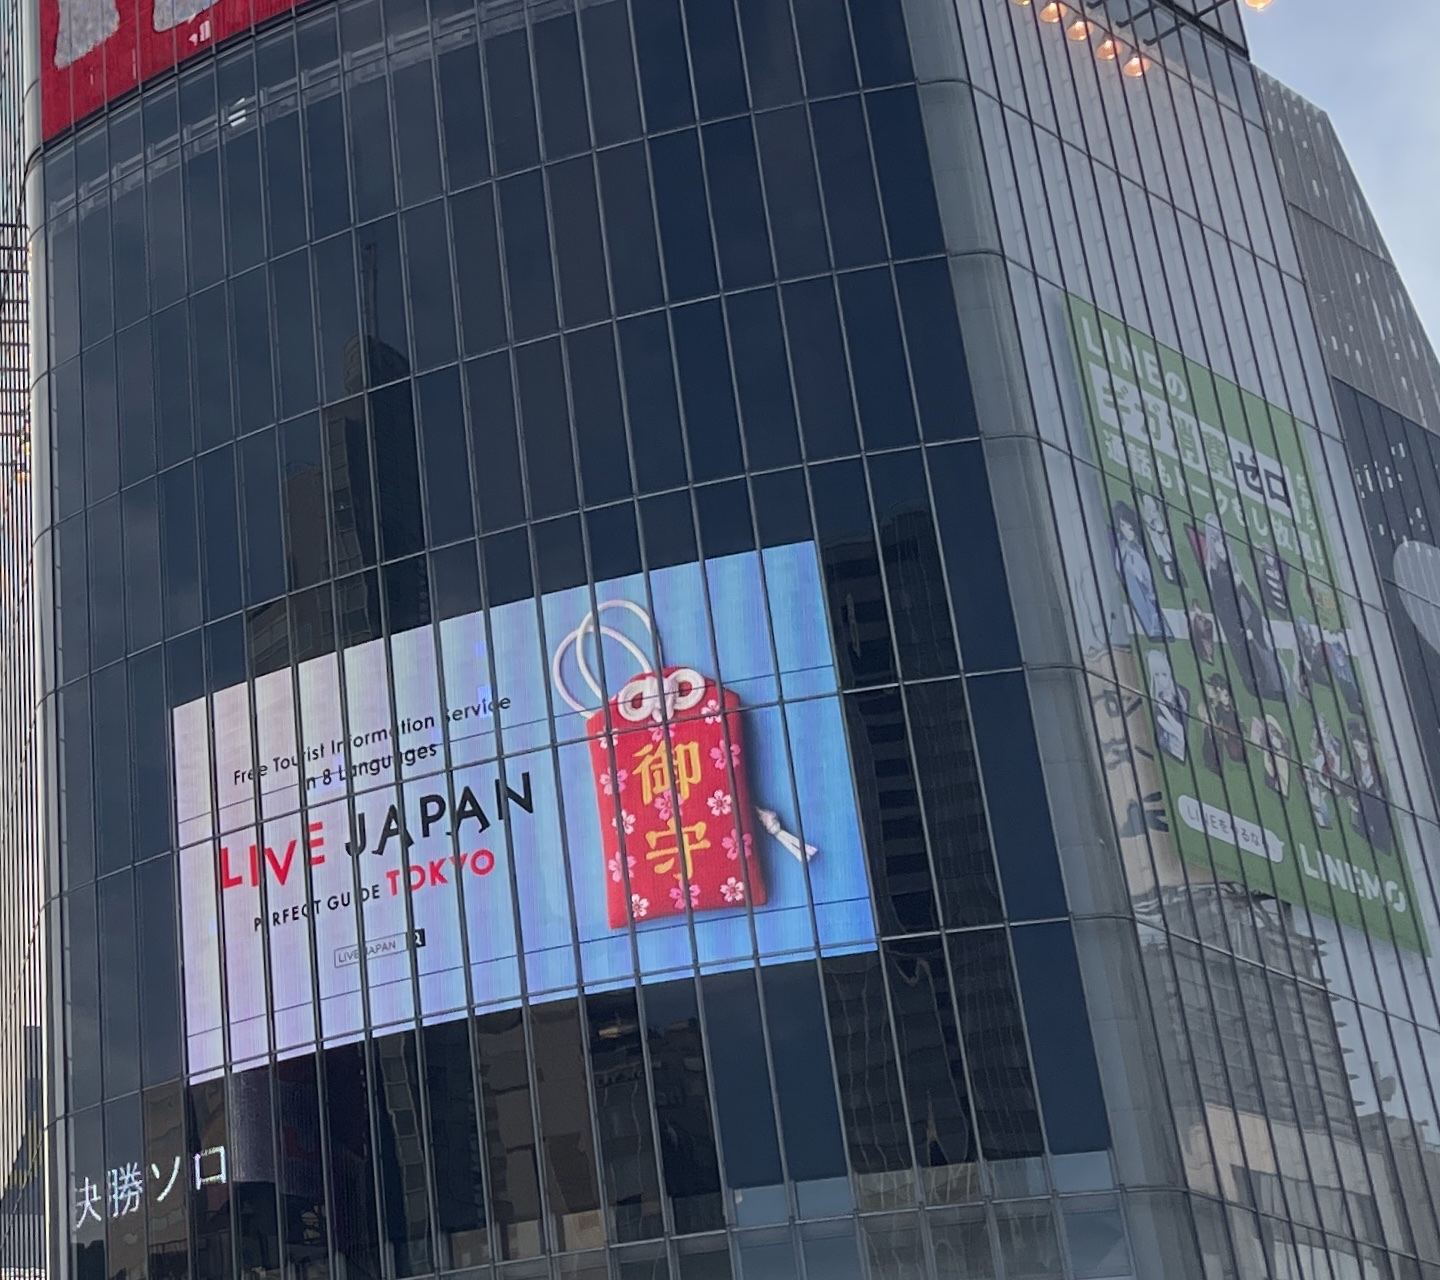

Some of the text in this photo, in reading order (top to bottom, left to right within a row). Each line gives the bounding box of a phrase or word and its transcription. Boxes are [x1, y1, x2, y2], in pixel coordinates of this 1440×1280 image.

[233, 696, 511, 786] Free Tourist Inormtion ervice
[321, 766, 333, 787] 8
[221, 770, 535, 889] LIVE JAPAN
[632, 738, 712, 880] 御守
[1184, 803, 1278, 856] LINEをるな
[253, 849, 496, 931] PRFECT GUDE TOKYO
[1298, 841, 1407, 913] LINEMO
[76, 1145, 227, 1228] 決勝ソロ
